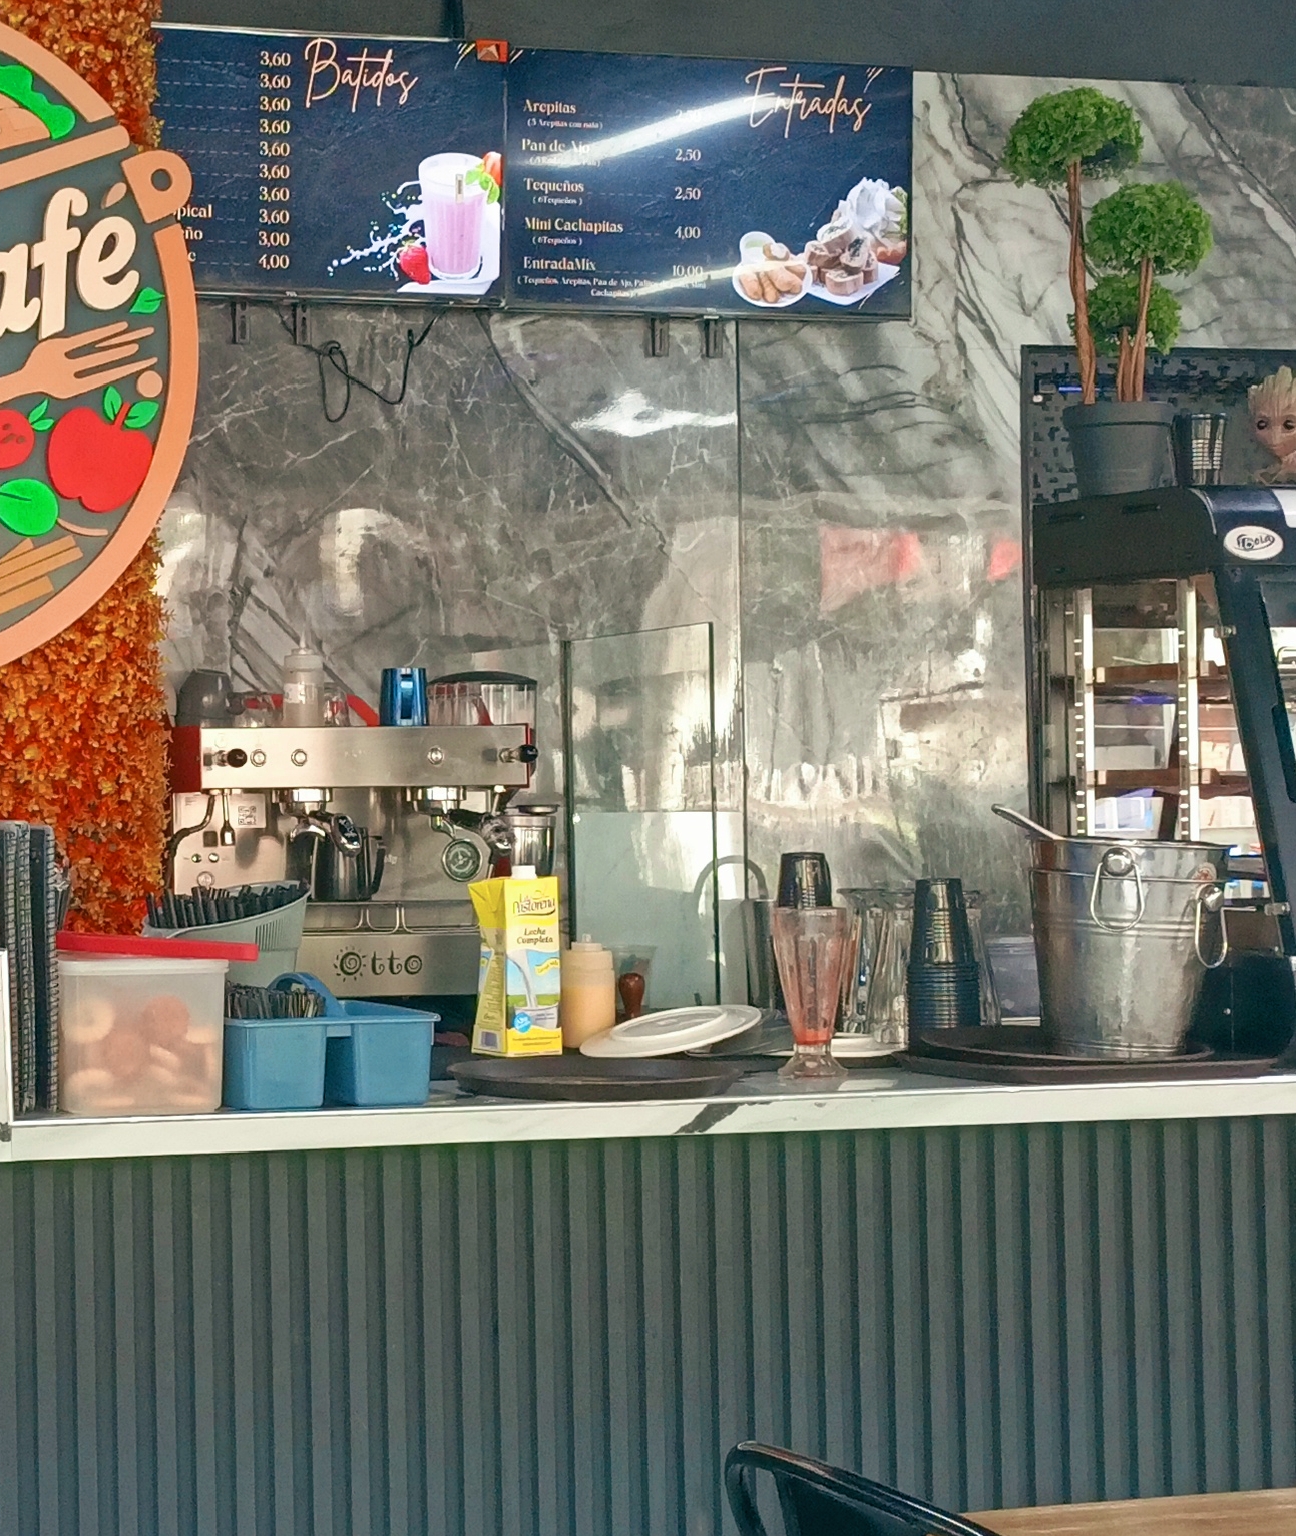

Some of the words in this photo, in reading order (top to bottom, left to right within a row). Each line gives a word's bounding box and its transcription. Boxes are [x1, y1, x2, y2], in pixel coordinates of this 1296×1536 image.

[260, 51, 291, 67] 3,60
[260, 73, 291, 89] 3,60
[304, 37, 419, 113] Batidos
[260, 96, 291, 112] 3,60
[523, 99, 576, 115] Arepitas
[745, 67, 871, 138] Entradas
[259, 118, 290, 135] 3,60
[259, 141, 290, 157] 3,60
[521, 138, 546, 152] Pan
[549, 139, 565, 152] de
[675, 148, 701, 162] 2,50
[259, 164, 290, 180] 3,60
[259, 186, 290, 202] 3,60
[524, 178, 584, 194] Tequeños
[674, 186, 701, 200] 2,50
[174, 204, 213, 221] pical
[259, 209, 290, 225] 3,60
[525, 217, 552, 231] Mini
[554, 218, 624, 235] Cachapitas
[674, 226, 701, 240] 4,00
[258, 231, 290, 248] 3,00
[258, 254, 290, 270] 4,00
[672, 265, 703, 278] 10,00
